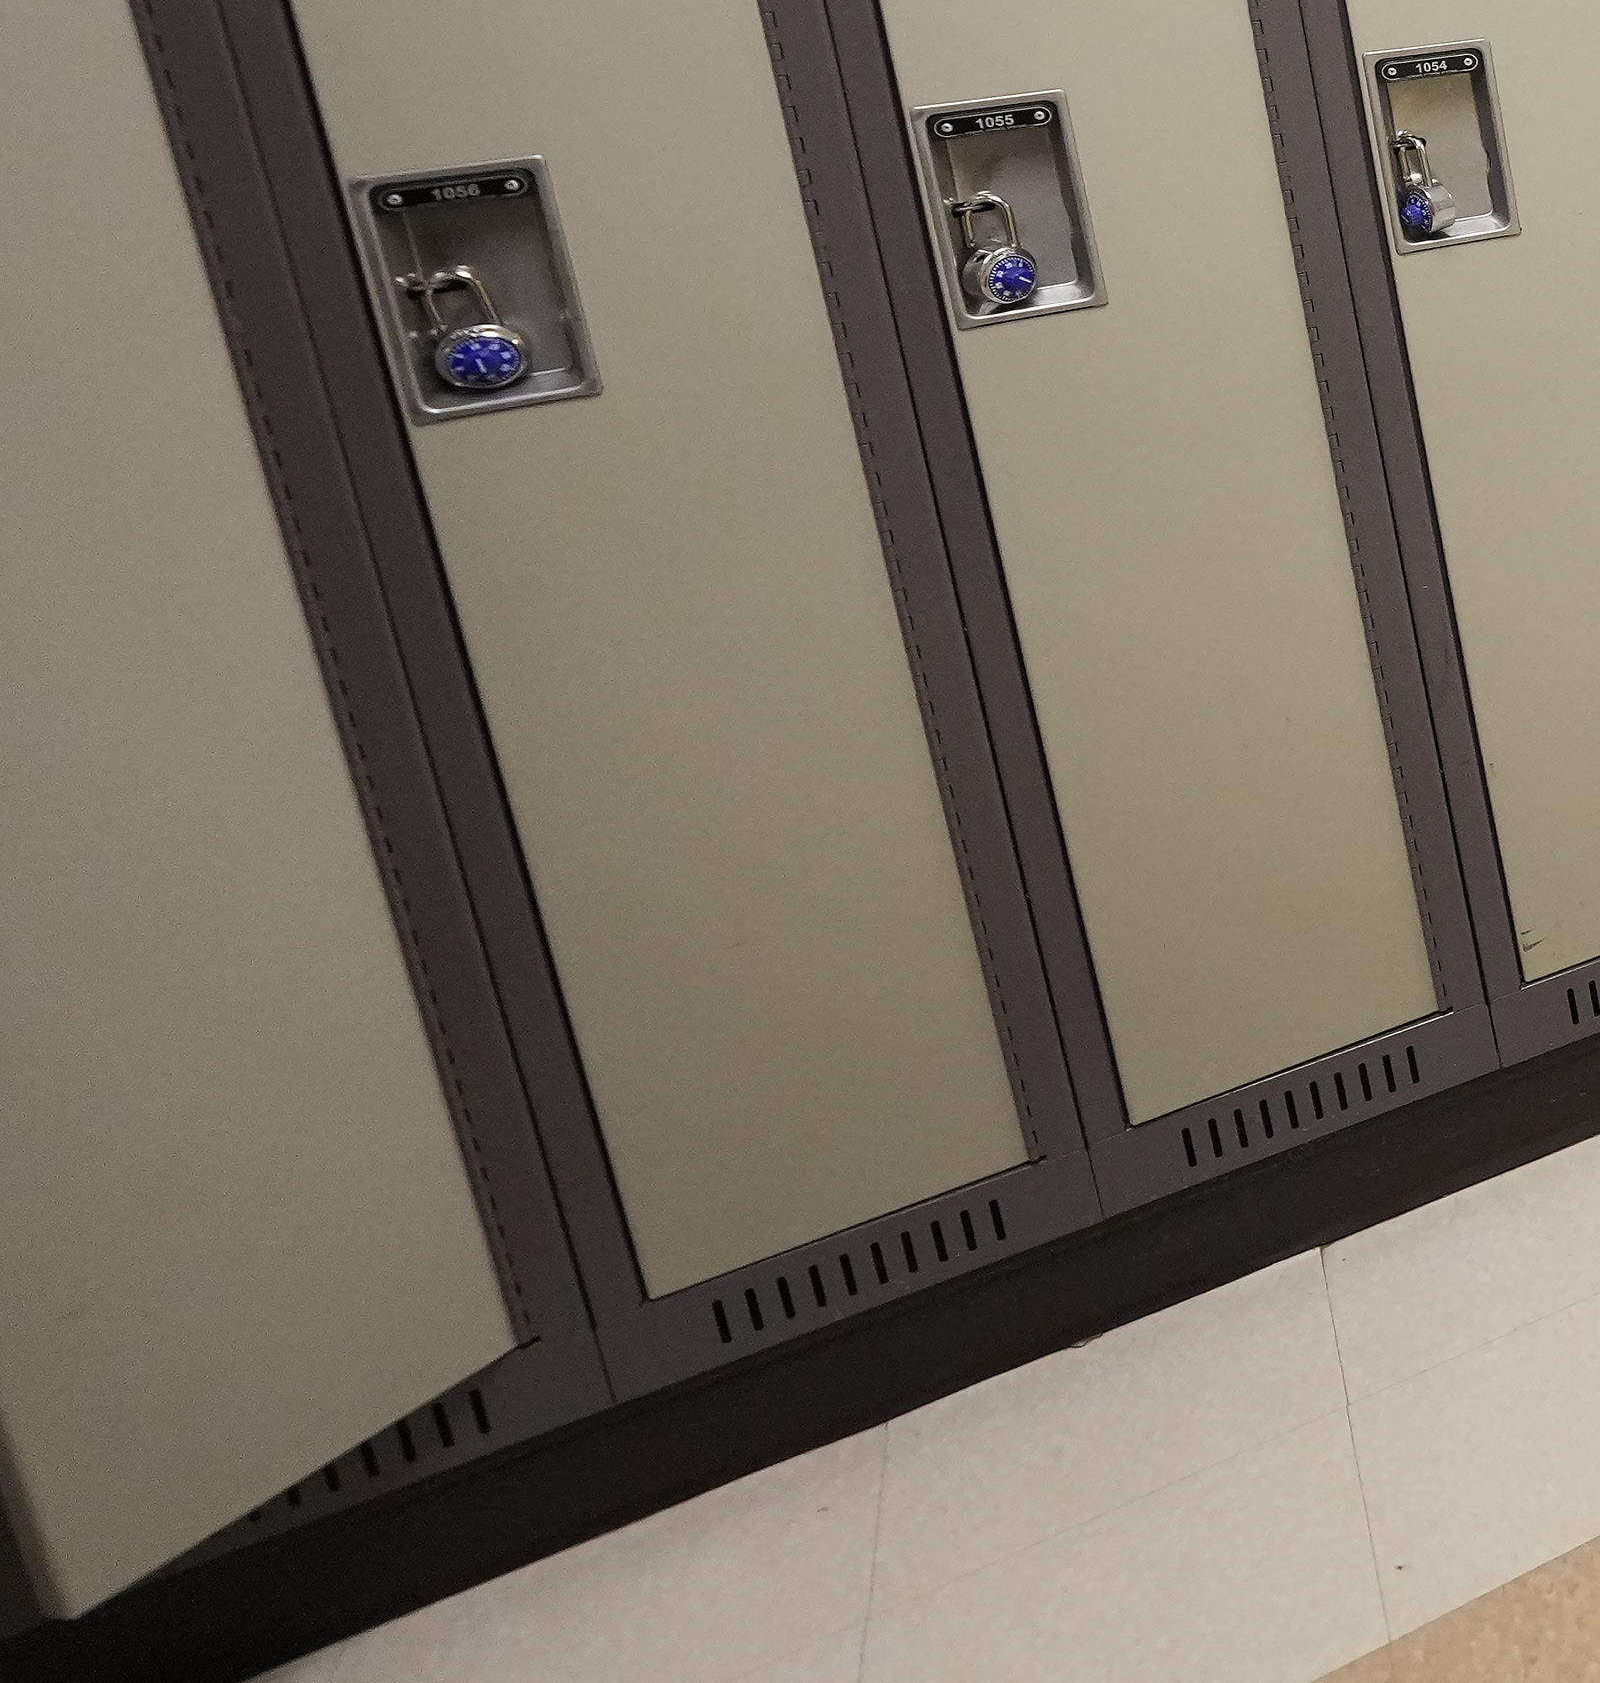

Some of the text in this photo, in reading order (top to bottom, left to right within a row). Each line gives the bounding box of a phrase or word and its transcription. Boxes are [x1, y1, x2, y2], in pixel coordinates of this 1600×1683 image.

[1415, 60, 1447, 73] 1054
[976, 114, 1014, 129] 1055
[432, 184, 480, 200] 1056
